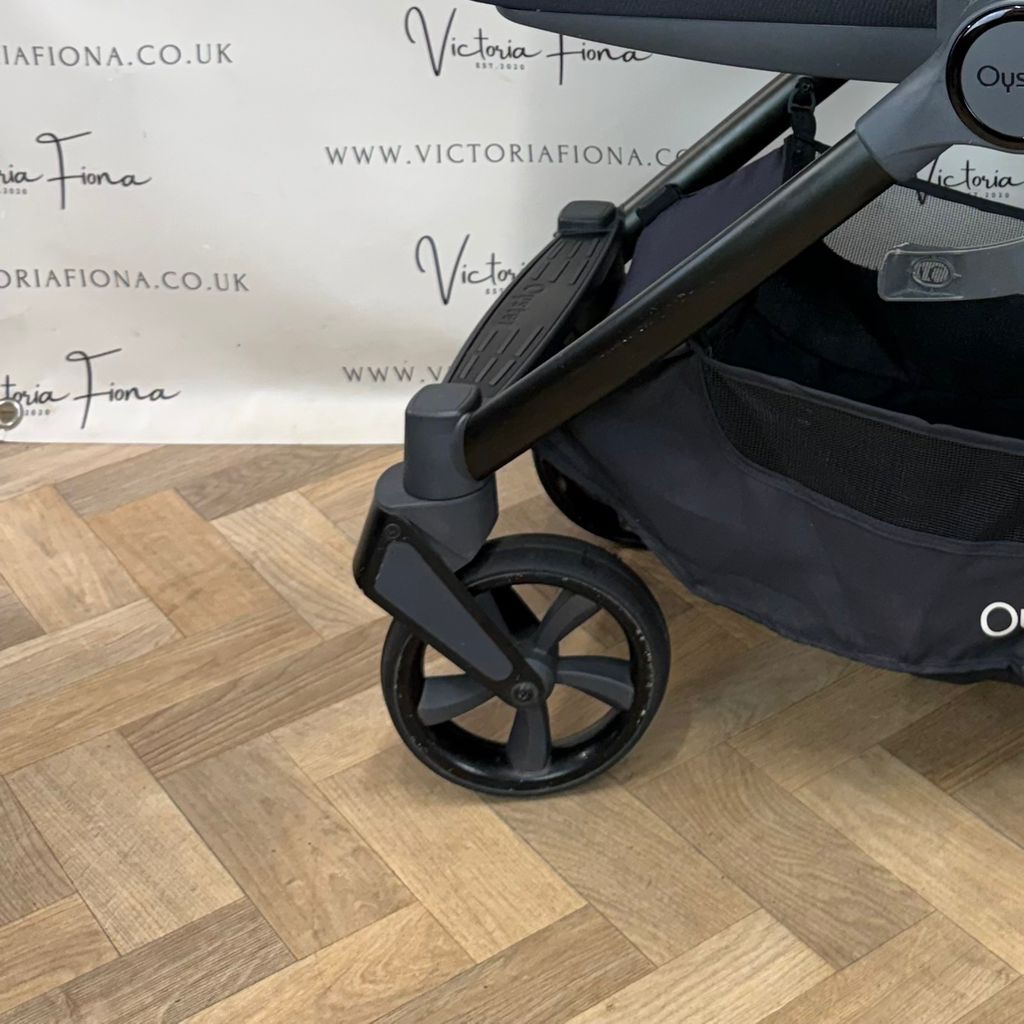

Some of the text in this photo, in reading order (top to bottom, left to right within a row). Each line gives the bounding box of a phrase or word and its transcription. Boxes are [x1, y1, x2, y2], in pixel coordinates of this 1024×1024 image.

[404, 7, 542, 77] Victoria
[36, 131, 152, 210] Fiona
[66, 347, 182, 430] Fiona
